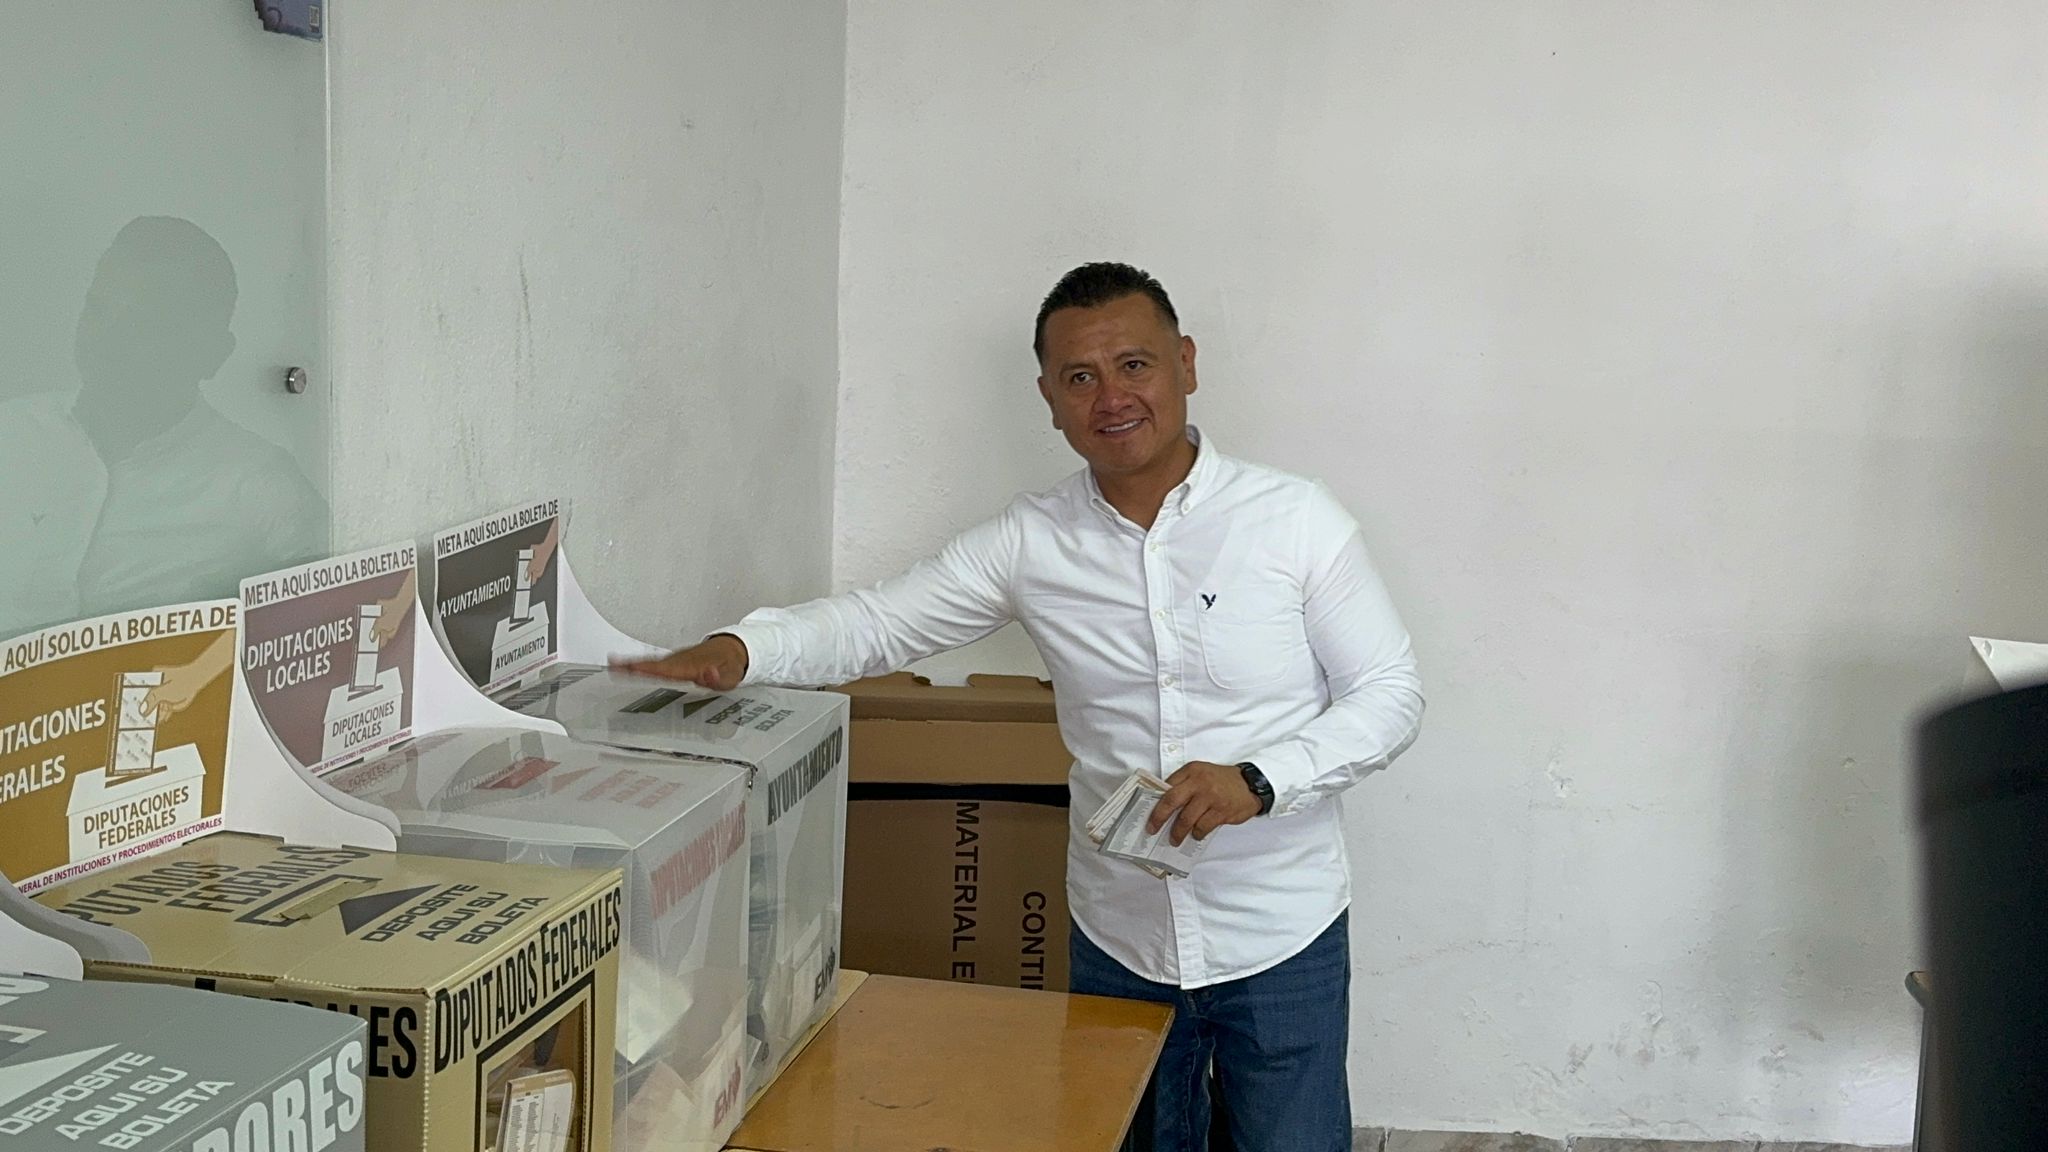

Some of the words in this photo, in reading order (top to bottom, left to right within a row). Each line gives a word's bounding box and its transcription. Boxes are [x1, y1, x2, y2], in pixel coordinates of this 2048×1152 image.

[437, 533, 462, 557] META
[463, 521, 485, 547] AQUÍ
[486, 517, 507, 539] SOLO
[508, 513, 518, 529] LA
[519, 503, 548, 526] BOLETA
[548, 499, 558, 516] DE
[244, 580, 278, 607] META
[282, 568, 311, 597] AQUÍ
[313, 565, 343, 589] SOLO
[345, 561, 359, 580] LA
[360, 551, 400, 577] BOLETA
[401, 547, 415, 567] DE
[440, 575, 511, 618] AYUNTAMIENTO
[4, 633, 45, 672] AQUÍ
[48, 626, 94, 658] SOLO
[99, 621, 122, 646] LA
[127, 609, 204, 641] BOLETA
[209, 604, 237, 628] DE
[247, 616, 353, 671] DIPUTACIONES
[494, 636, 545, 671] AYUNTAMIENTO
[266, 651, 331, 693] LOCALES
[332, 700, 394, 737] DIPUTACIONES
[344, 721, 381, 749] LOCALES
[755, 709, 795, 732] BOLETA
[767, 725, 843, 826] AYUNTAMIENTO
[84, 785, 189, 834] DIPUTACIONES
[98, 808, 177, 849] FEDERALES
[43, 874, 53, 886] DE
[54, 853, 111, 884] INSTITUCIONES
[112, 853, 118, 862] Y
[118, 832, 177, 860] PROCEDIMIENTOS
[176, 817, 222, 839] ELECTORALES
[165, 846, 370, 913] FEDERALES
[951, 801, 980, 952] MATERIAL
[360, 883, 480, 942] DEPOSITE
[416, 906, 478, 941] AQUI
[473, 891, 509, 909] SU
[455, 896, 550, 945] BOLETA
[434, 940, 537, 1074] DIPUTADOS
[540, 886, 621, 1000] FEDERALES
[0, 1051, 156, 1135] DEPOSITE
[55, 1091, 147, 1141] AQUI
[129, 1066, 188, 1095] SU
[97, 1079, 236, 1150] BOLETA
